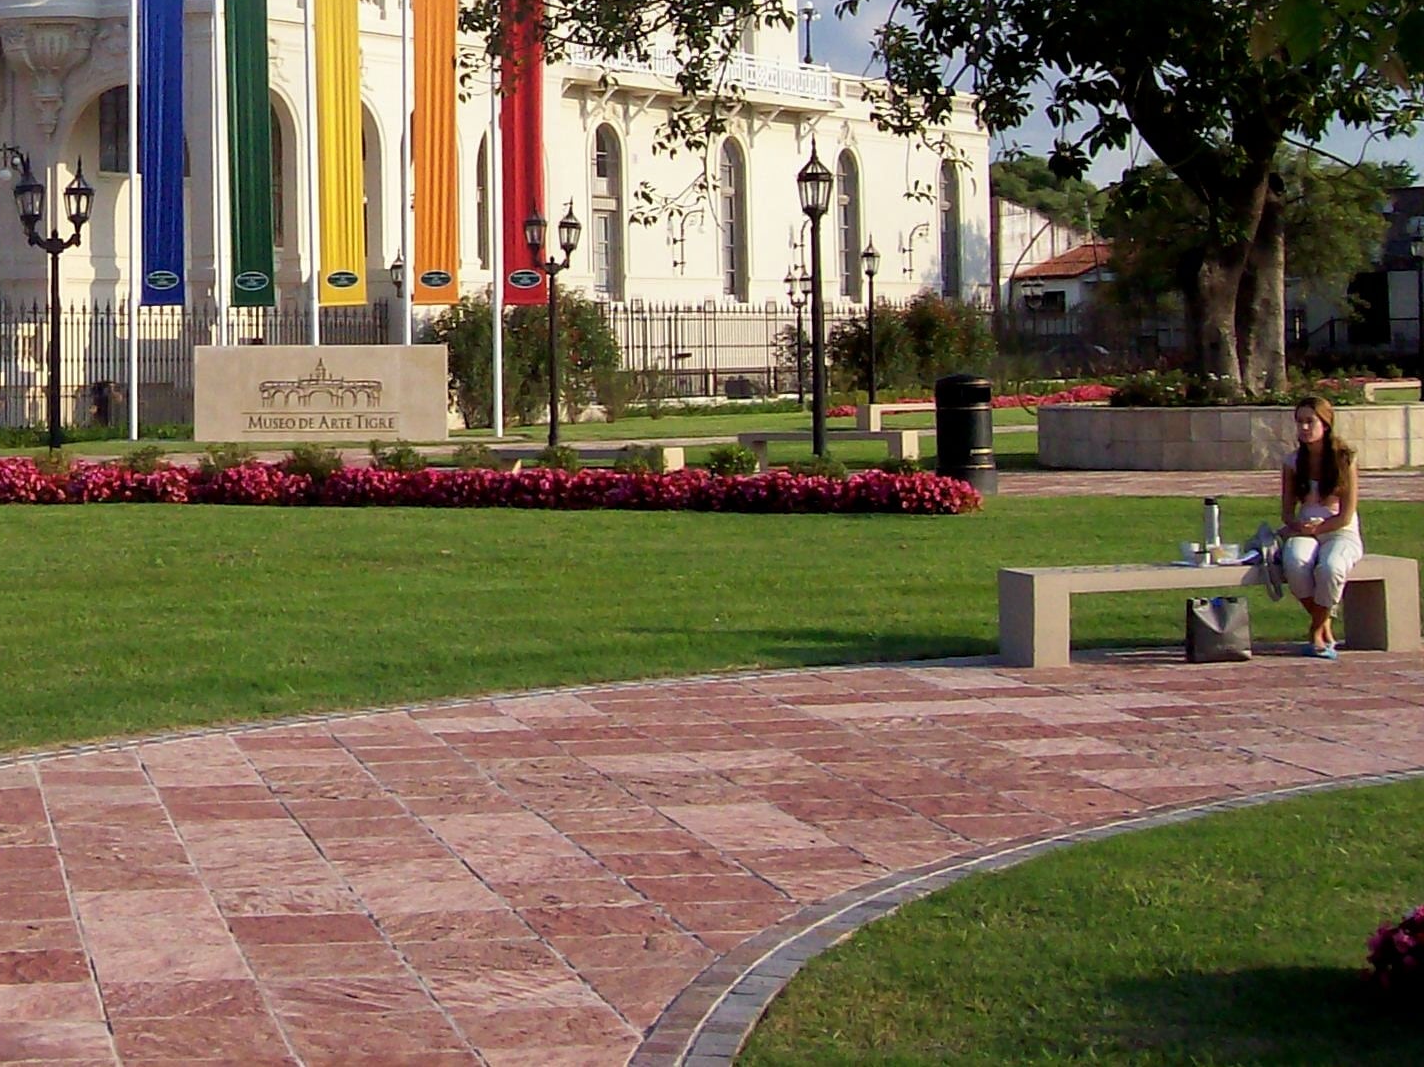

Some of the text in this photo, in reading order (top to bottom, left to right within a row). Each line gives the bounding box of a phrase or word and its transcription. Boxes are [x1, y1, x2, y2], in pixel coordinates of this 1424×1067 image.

[248, 415, 395, 429] MUSEO DE ARTE TIGRE
